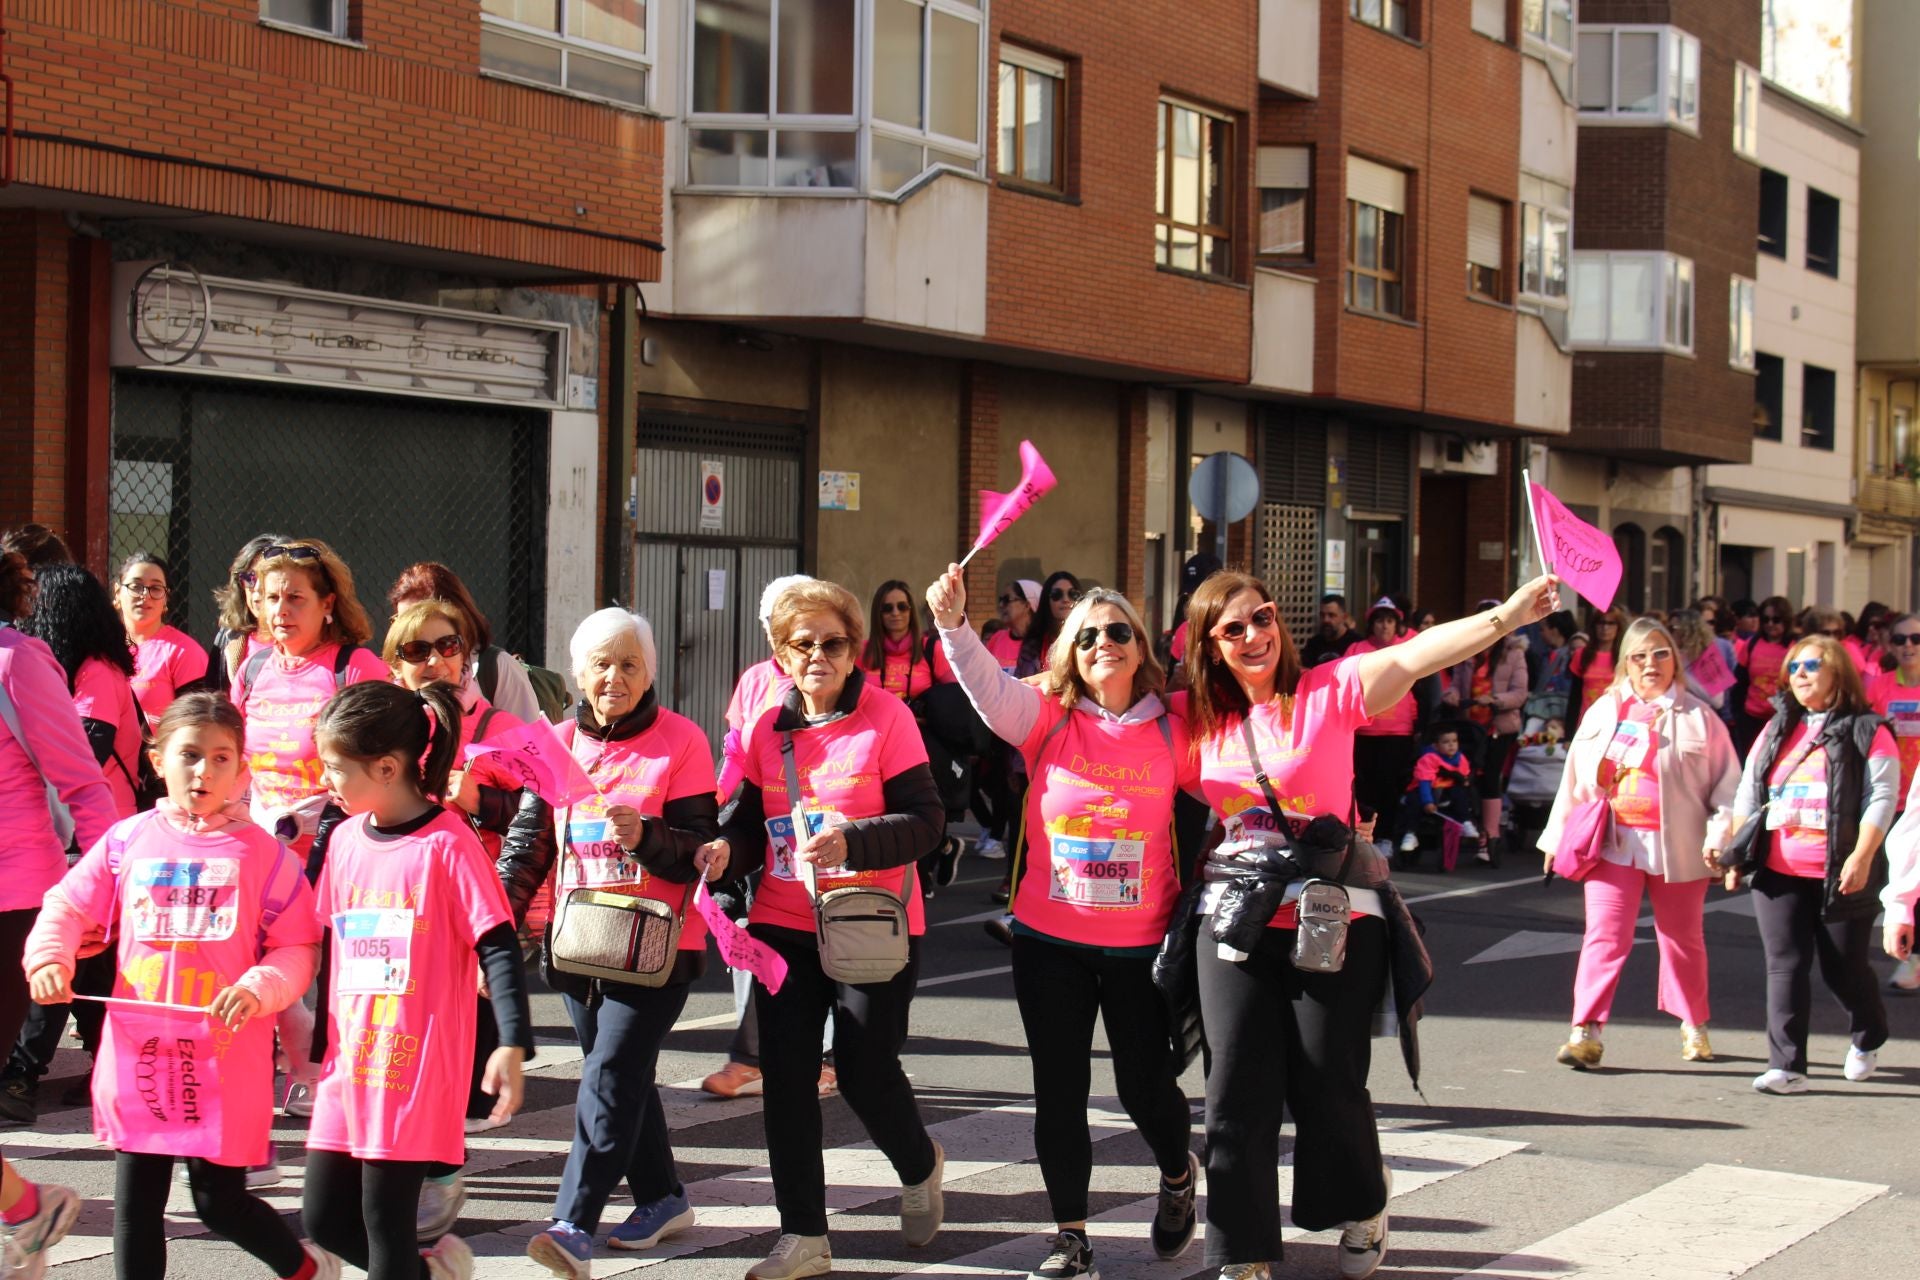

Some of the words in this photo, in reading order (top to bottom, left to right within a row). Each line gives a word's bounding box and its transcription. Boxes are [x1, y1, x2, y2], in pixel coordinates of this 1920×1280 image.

[1253, 815, 1300, 834] 408
[583, 842, 622, 858] 4064
[1082, 862, 1129, 878] 4065
[166, 888, 218, 905] 4887
[351, 938, 391, 958] 1055
[176, 1037, 200, 1124] Ezedent
